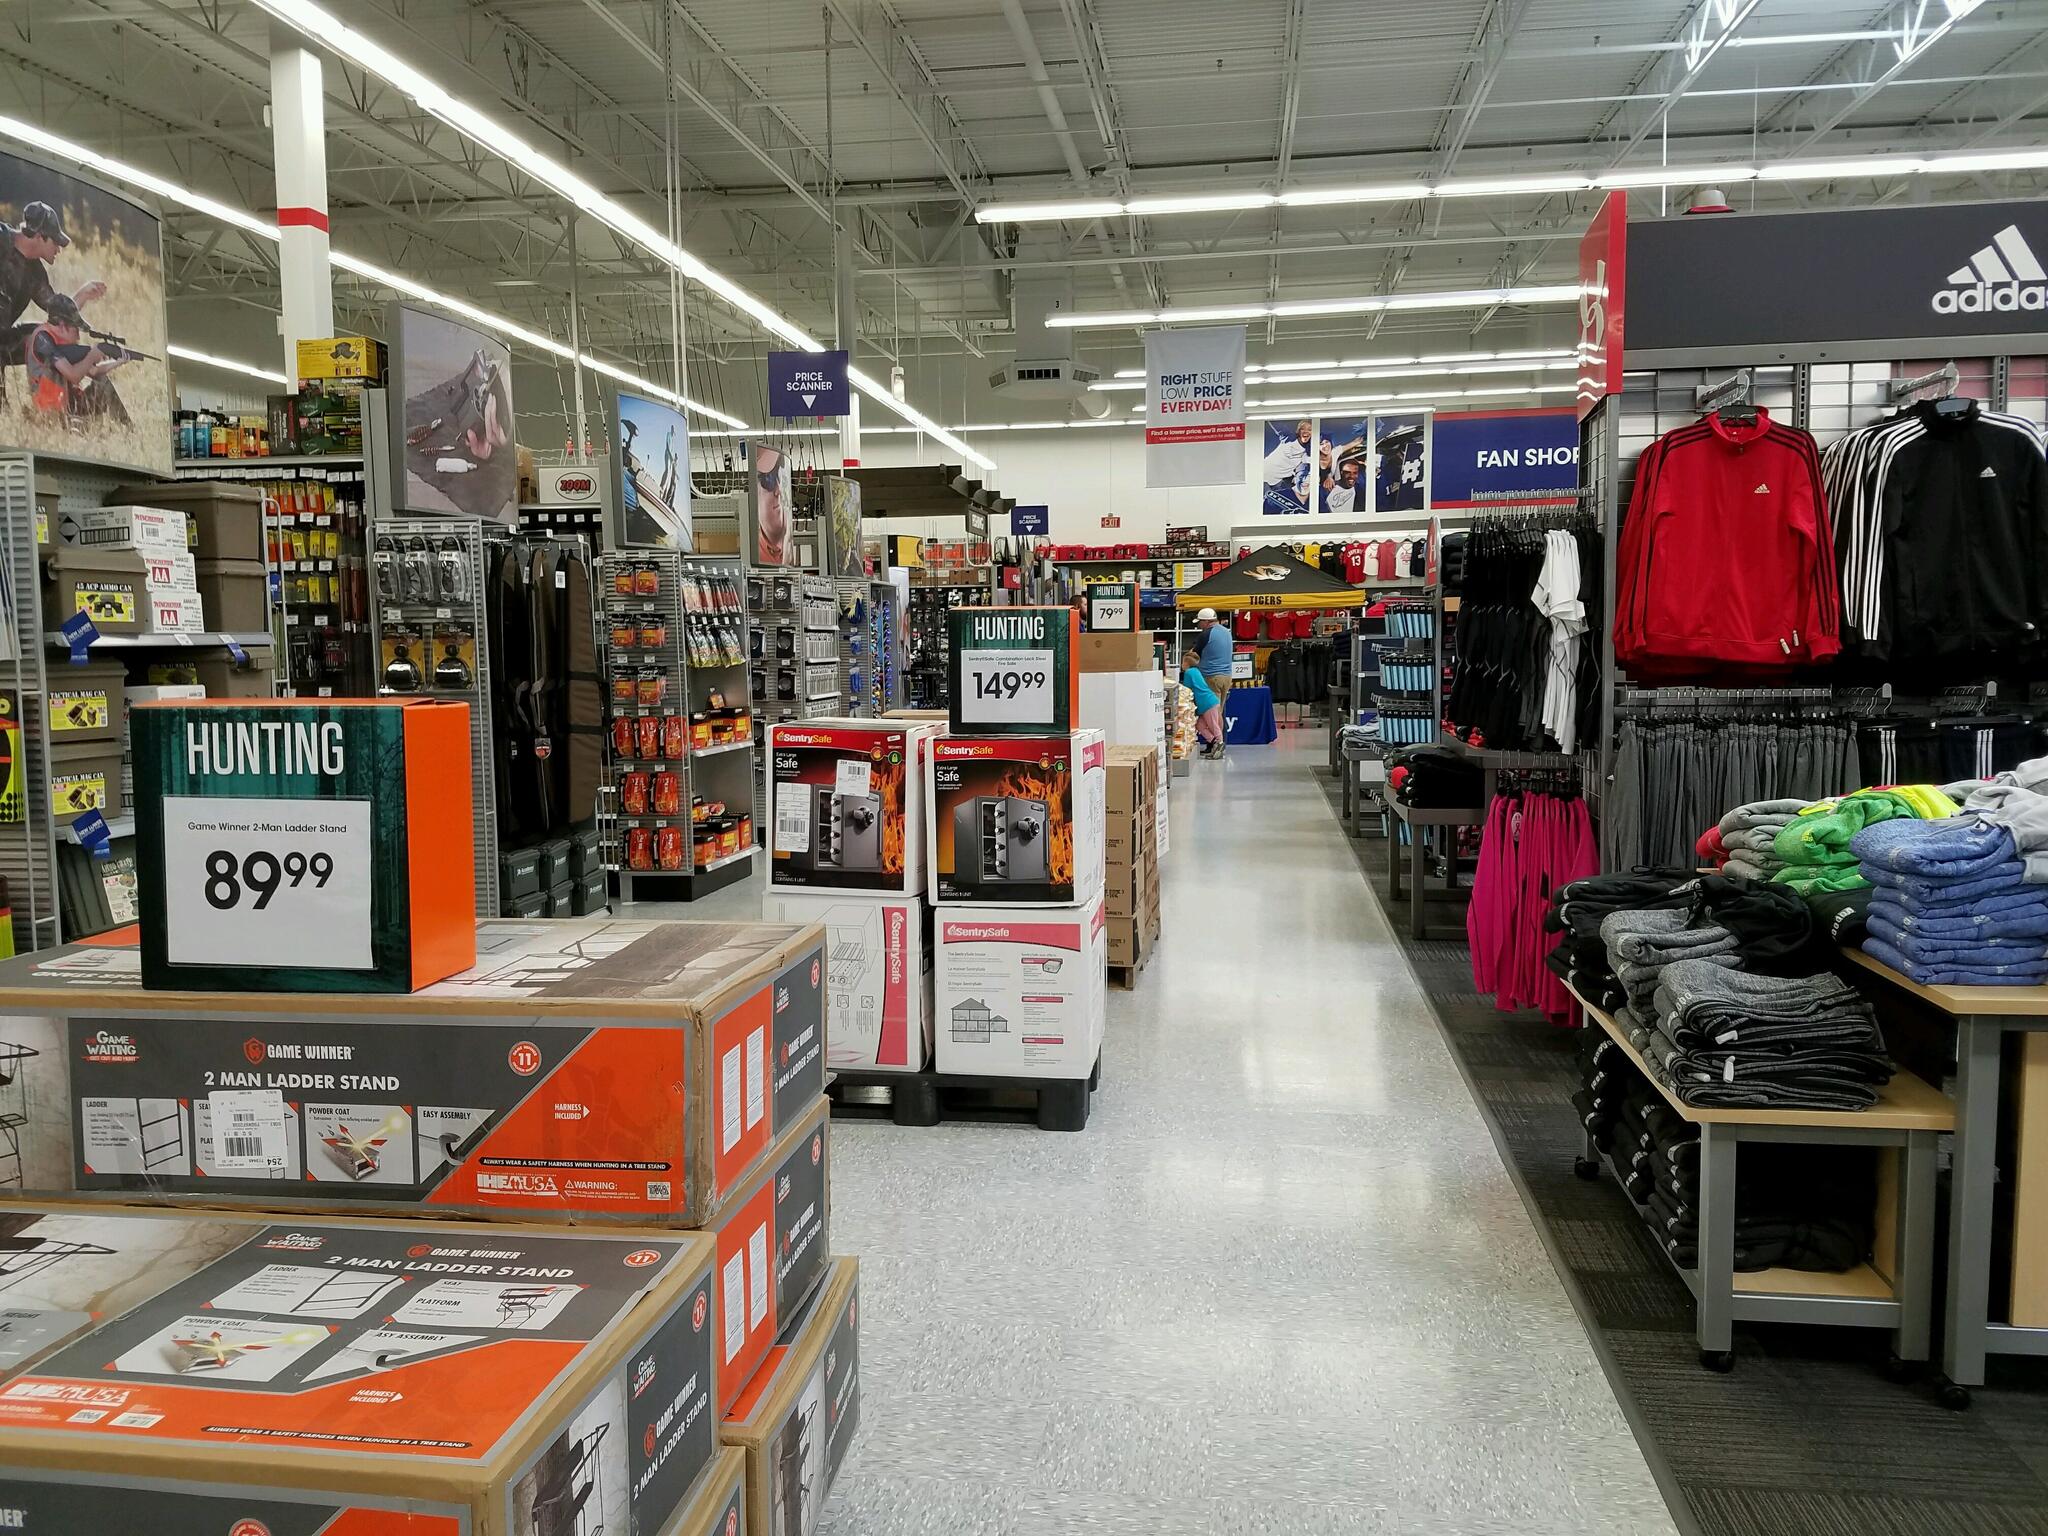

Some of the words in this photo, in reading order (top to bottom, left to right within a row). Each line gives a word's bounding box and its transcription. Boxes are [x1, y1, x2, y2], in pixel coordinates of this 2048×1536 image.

[1932, 280, 2048, 315] adida
[795, 372, 822, 381] PRICE
[1161, 374, 1197, 385] RIGHT
[1201, 372, 1232, 384] STUFF
[787, 382, 832, 391] SCANNER
[1161, 388, 1189, 400] LOW
[1194, 385, 1232, 398] PRICE
[1161, 398, 1232, 413] EVERYDAY!
[1477, 449, 1518, 468] FAN
[560, 480, 591, 491] ZOOM
[1104, 518, 1118, 527] EXIT
[1351, 555, 1361, 566] 13
[155, 568, 169, 583] AA
[99, 583, 119, 591] AMMO
[1097, 586, 1125, 596] HUNTING
[1250, 595, 1282, 605] TIGERS
[162, 611, 178, 626] AA
[1243, 611, 1251, 621] 4
[975, 616, 1045, 640] HUNTING
[50, 691, 78, 699] TACTICAL
[784, 733, 832, 743] SentrySafe
[187, 722, 344, 775] HUNTING
[944, 746, 993, 755] SentrySafe
[776, 758, 798, 768] Safe
[52, 773, 78, 783] TACTICAL
[937, 771, 960, 781] Safe
[188, 822, 216, 832] Game
[219, 822, 250, 832] Winner
[252, 822, 282, 833] 2-Man
[285, 823, 317, 834] Ladder
[320, 823, 347, 833] Stand
[956, 927, 1009, 937] SentrySafe
[891, 922, 902, 985] SentrySafe
[96, 1030, 130, 1044] GAME
[86, 1044, 136, 1055] WAITING
[267, 1045, 301, 1059] GAME
[789, 1037, 800, 1057] GAME
[519, 1053, 531, 1066] 11
[774, 1081, 778, 1095] 2
[779, 1070, 790, 1090] MAN
[790, 1056, 806, 1079] LADDER
[806, 1043, 820, 1063] STAND
[204, 1071, 215, 1086] 2
[220, 1072, 261, 1088] MAN
[267, 1074, 335, 1090] LADDER
[340, 1076, 400, 1092] STAND
[423, 1110, 439, 1120] EASY
[441, 1111, 471, 1120] ASSEMBLY
[574, 1181, 618, 1190] WARNING:
[285, 1233, 322, 1241] GAME
[267, 1239, 322, 1247] WAITING
[430, 1248, 469, 1257] GAME
[782, 1256, 791, 1280] MAN
[792, 1238, 807, 1269] LADDER
[808, 1219, 822, 1243] STAND
[633, 1253, 650, 1263] 11
[325, 1256, 342, 1264] 2
[343, 1257, 402, 1269] MAN
[404, 1262, 493, 1275] LADDER
[496, 1266, 574, 1278] STAND
[416, 1298, 460, 1306] PLATFORM
[696, 1307, 704, 1324] 11
[184, 1318, 220, 1326] POWDER
[395, 1333, 447, 1341] ASSEMBLY
[634, 1362, 656, 1393] WAITING
[356, 1389, 396, 1397] HARNESS
[349, 1396, 388, 1404] INCLUDED
[656, 1403, 674, 1438] GAME
[300, 1432, 336, 1440] HARNESS
[633, 1484, 639, 1501] 2
[640, 1458, 658, 1492] MAN
[659, 1425, 686, 1467] LADDER
[686, 1392, 707, 1428] STAND
